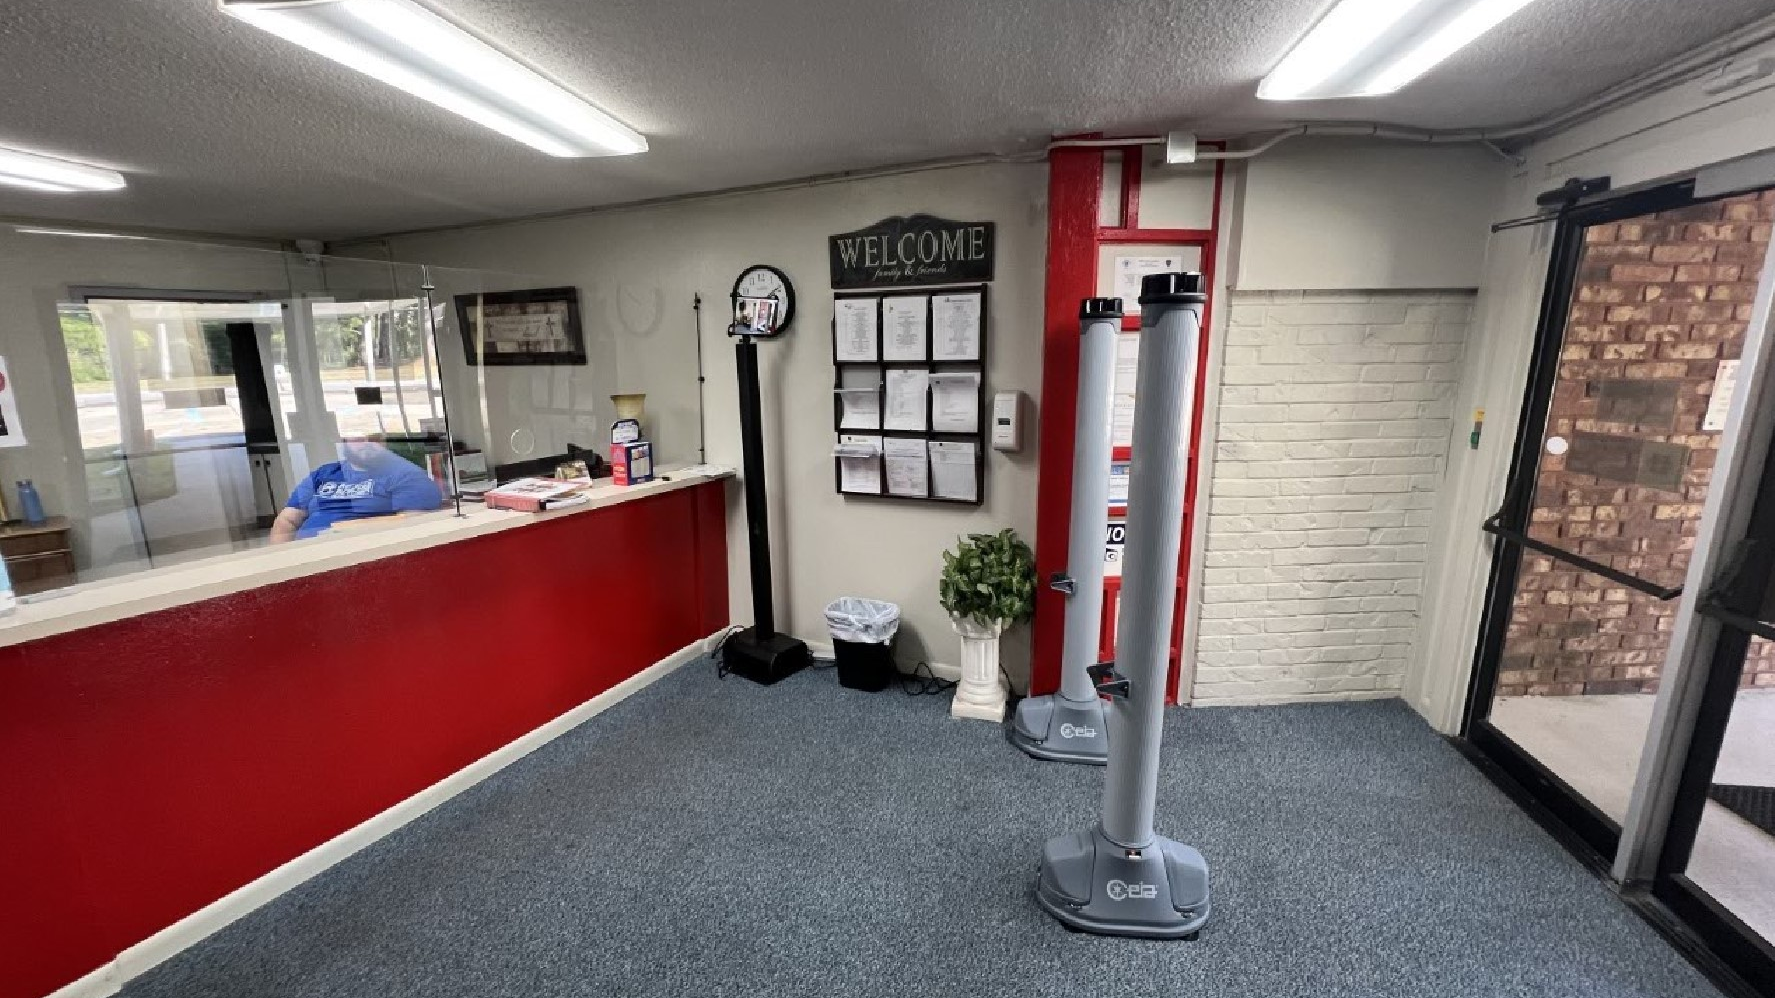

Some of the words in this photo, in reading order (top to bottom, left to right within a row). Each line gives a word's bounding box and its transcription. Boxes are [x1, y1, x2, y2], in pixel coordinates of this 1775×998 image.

[837, 226, 985, 269] WELCOME
[872, 267, 901, 282] family
[904, 264, 914, 276] &
[915, 263, 947, 277] friends
